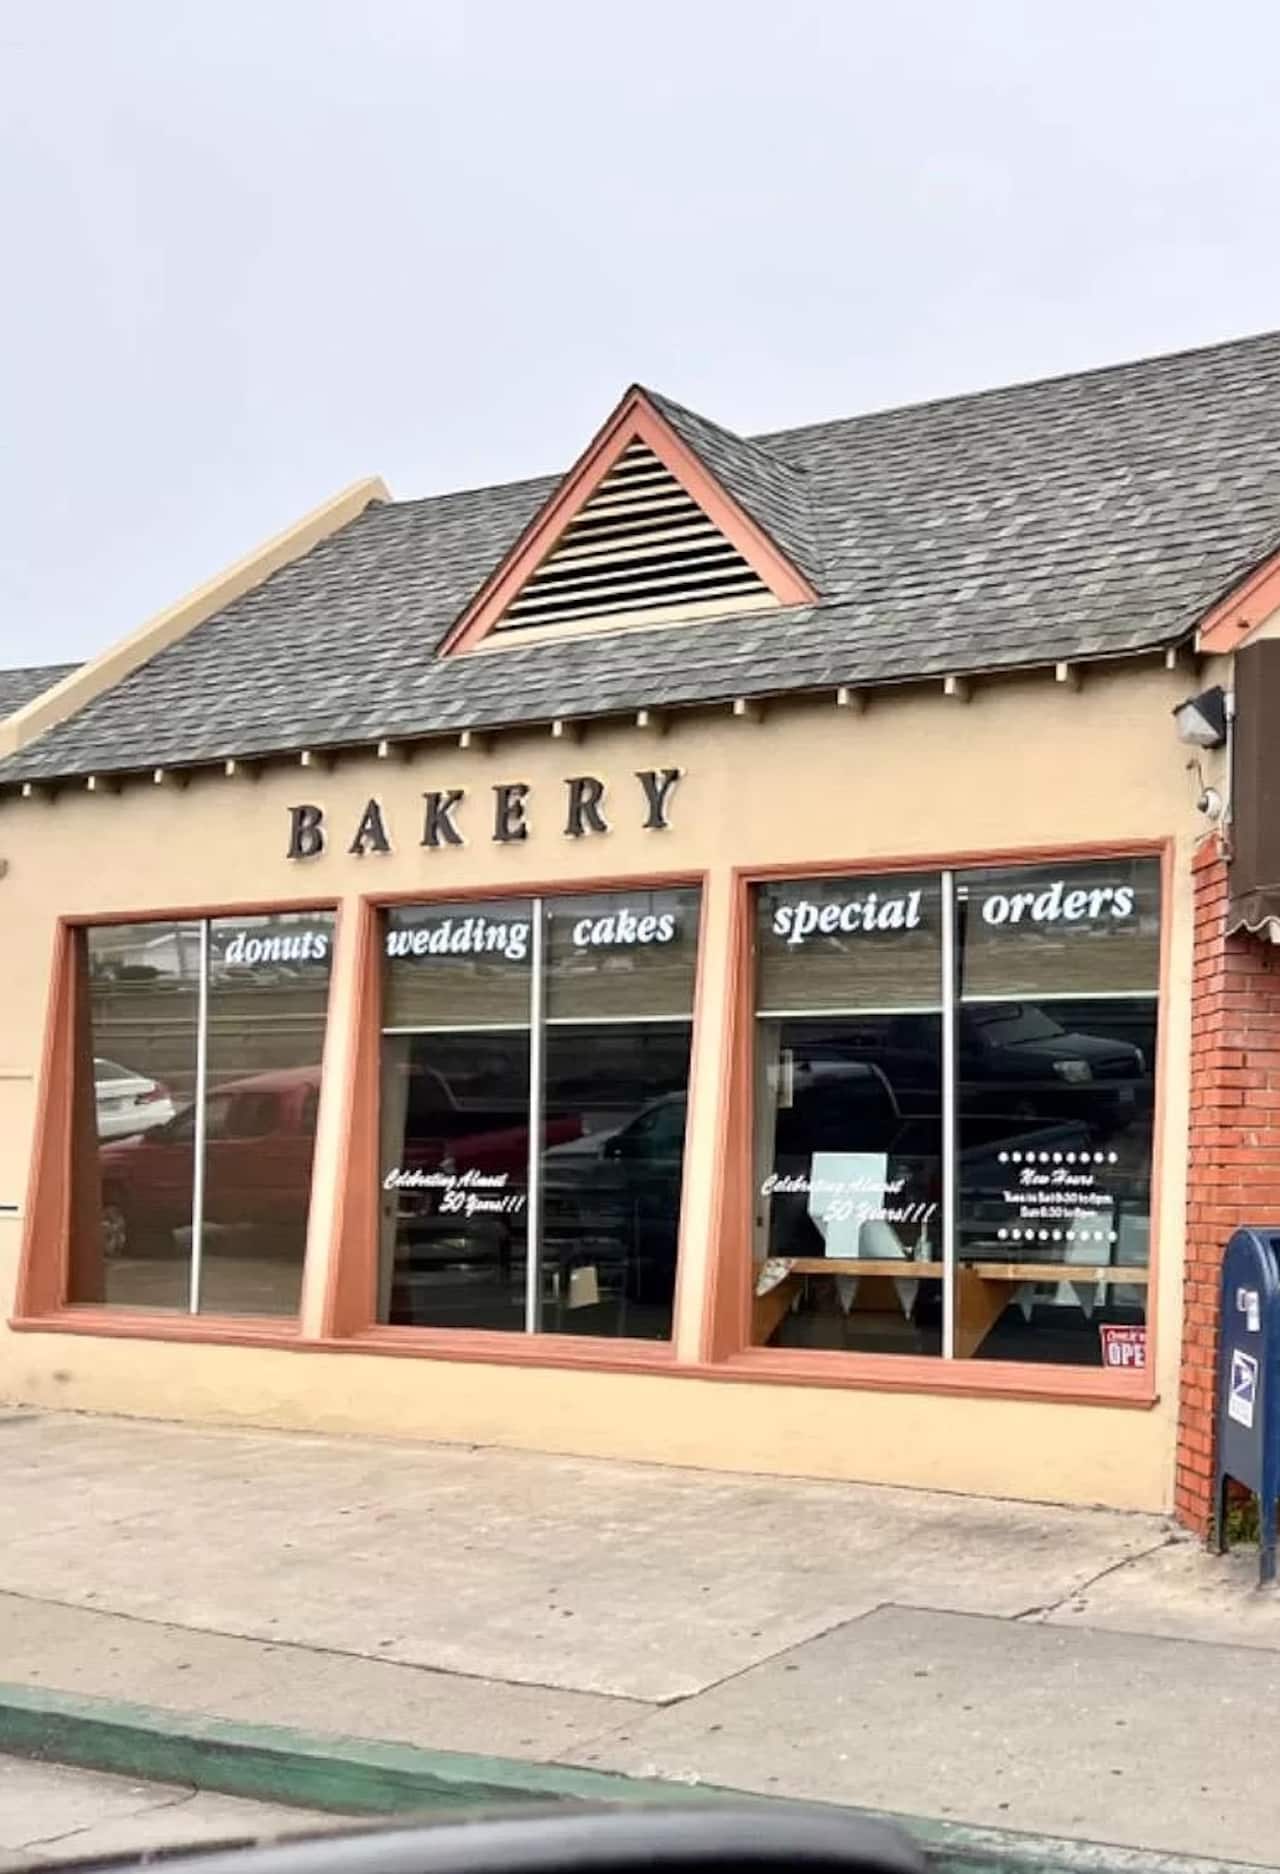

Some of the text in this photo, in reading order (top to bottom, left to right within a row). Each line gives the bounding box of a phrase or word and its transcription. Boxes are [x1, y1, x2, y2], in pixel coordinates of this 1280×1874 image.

[286, 768, 684, 860] BAKERY
[773, 881, 1135, 943] special orders
[225, 930, 328, 965] donuts
[386, 910, 675, 960] wedding cakes
[383, 1167, 509, 1192] Celebrating Almost
[1019, 1167, 1095, 1187] New Hours
[438, 1190, 466, 1213] 50
[1108, 1342, 1145, 1367] OPE
